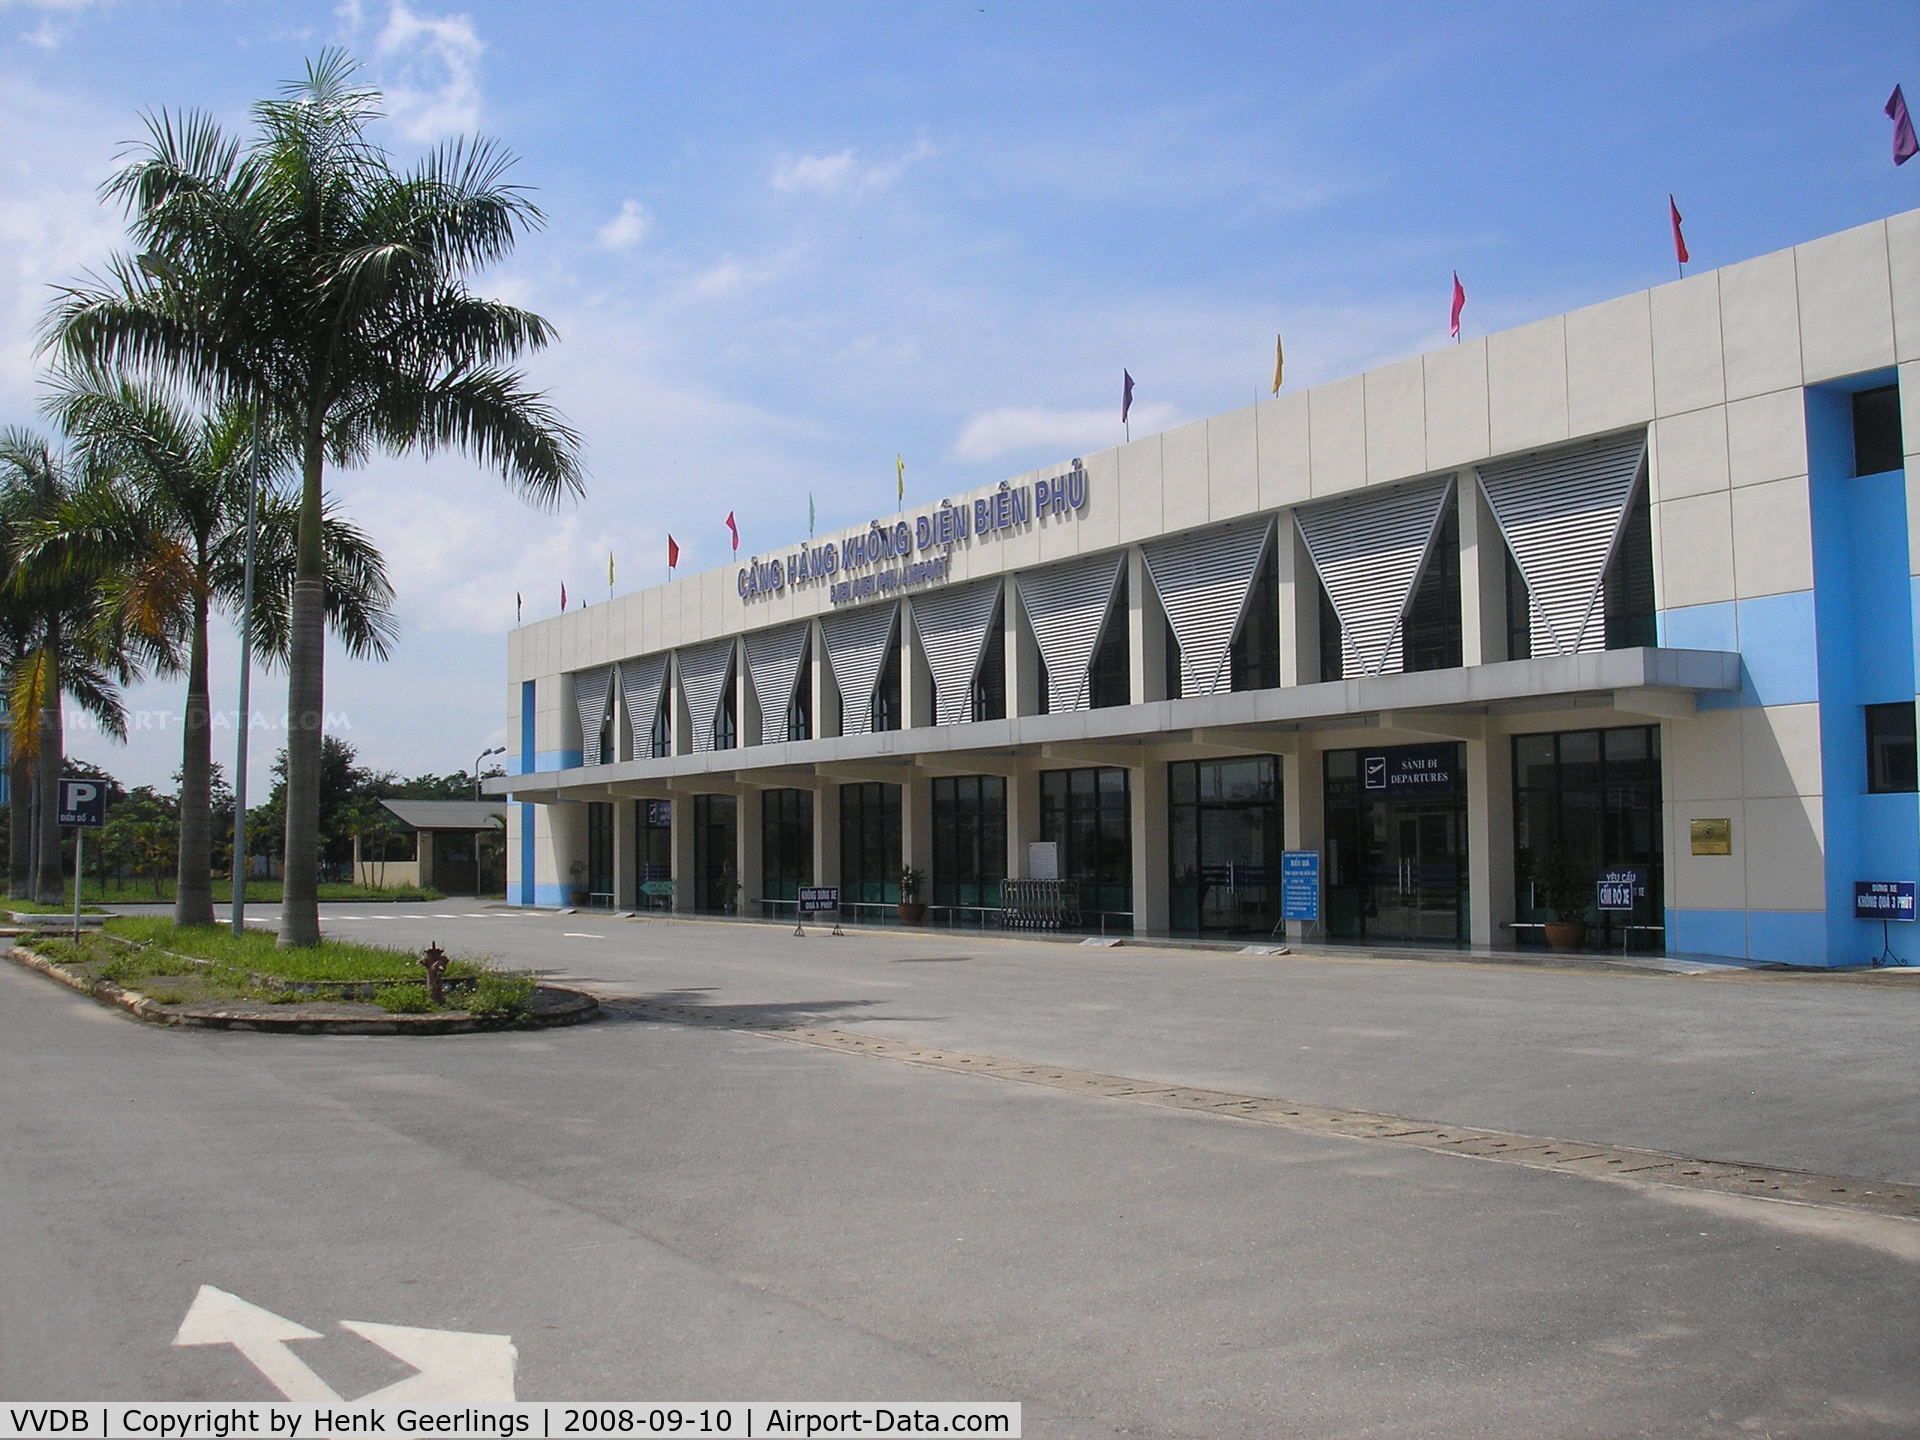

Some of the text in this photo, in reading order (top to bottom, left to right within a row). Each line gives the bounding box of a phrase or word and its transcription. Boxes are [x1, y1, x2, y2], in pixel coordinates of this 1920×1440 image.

[737, 457, 1087, 599] CẢNG HÀNG KHÔNG ĐIỆN BIÊN PHỦ
[901, 554, 949, 587] AIRPORT
[1426, 758, 1438, 769] ĐI
[1390, 772, 1449, 784] DEPARTURES
[67, 783, 97, 811] P
[1891, 895, 1896, 909] 3
